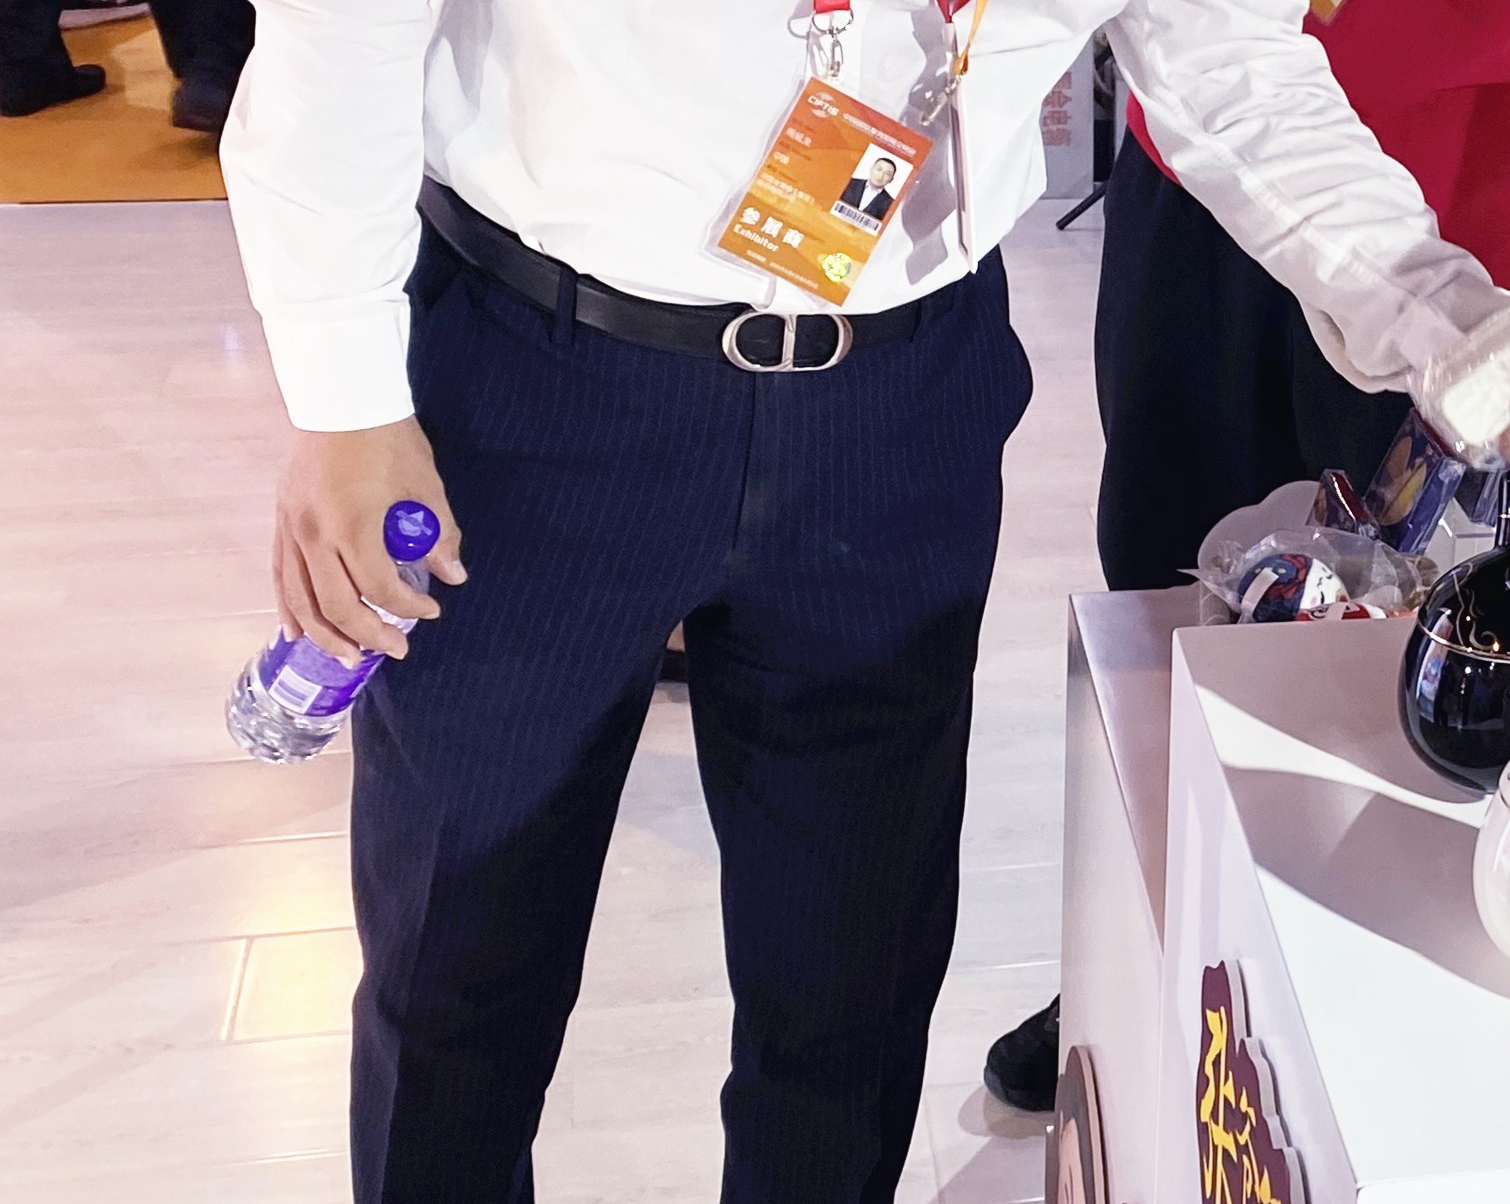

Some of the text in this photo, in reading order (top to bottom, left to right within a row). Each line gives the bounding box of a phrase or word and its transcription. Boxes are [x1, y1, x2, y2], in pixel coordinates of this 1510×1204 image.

[733, 224, 779, 253] Exhibitor
[739, 206, 805, 249] 参展商
